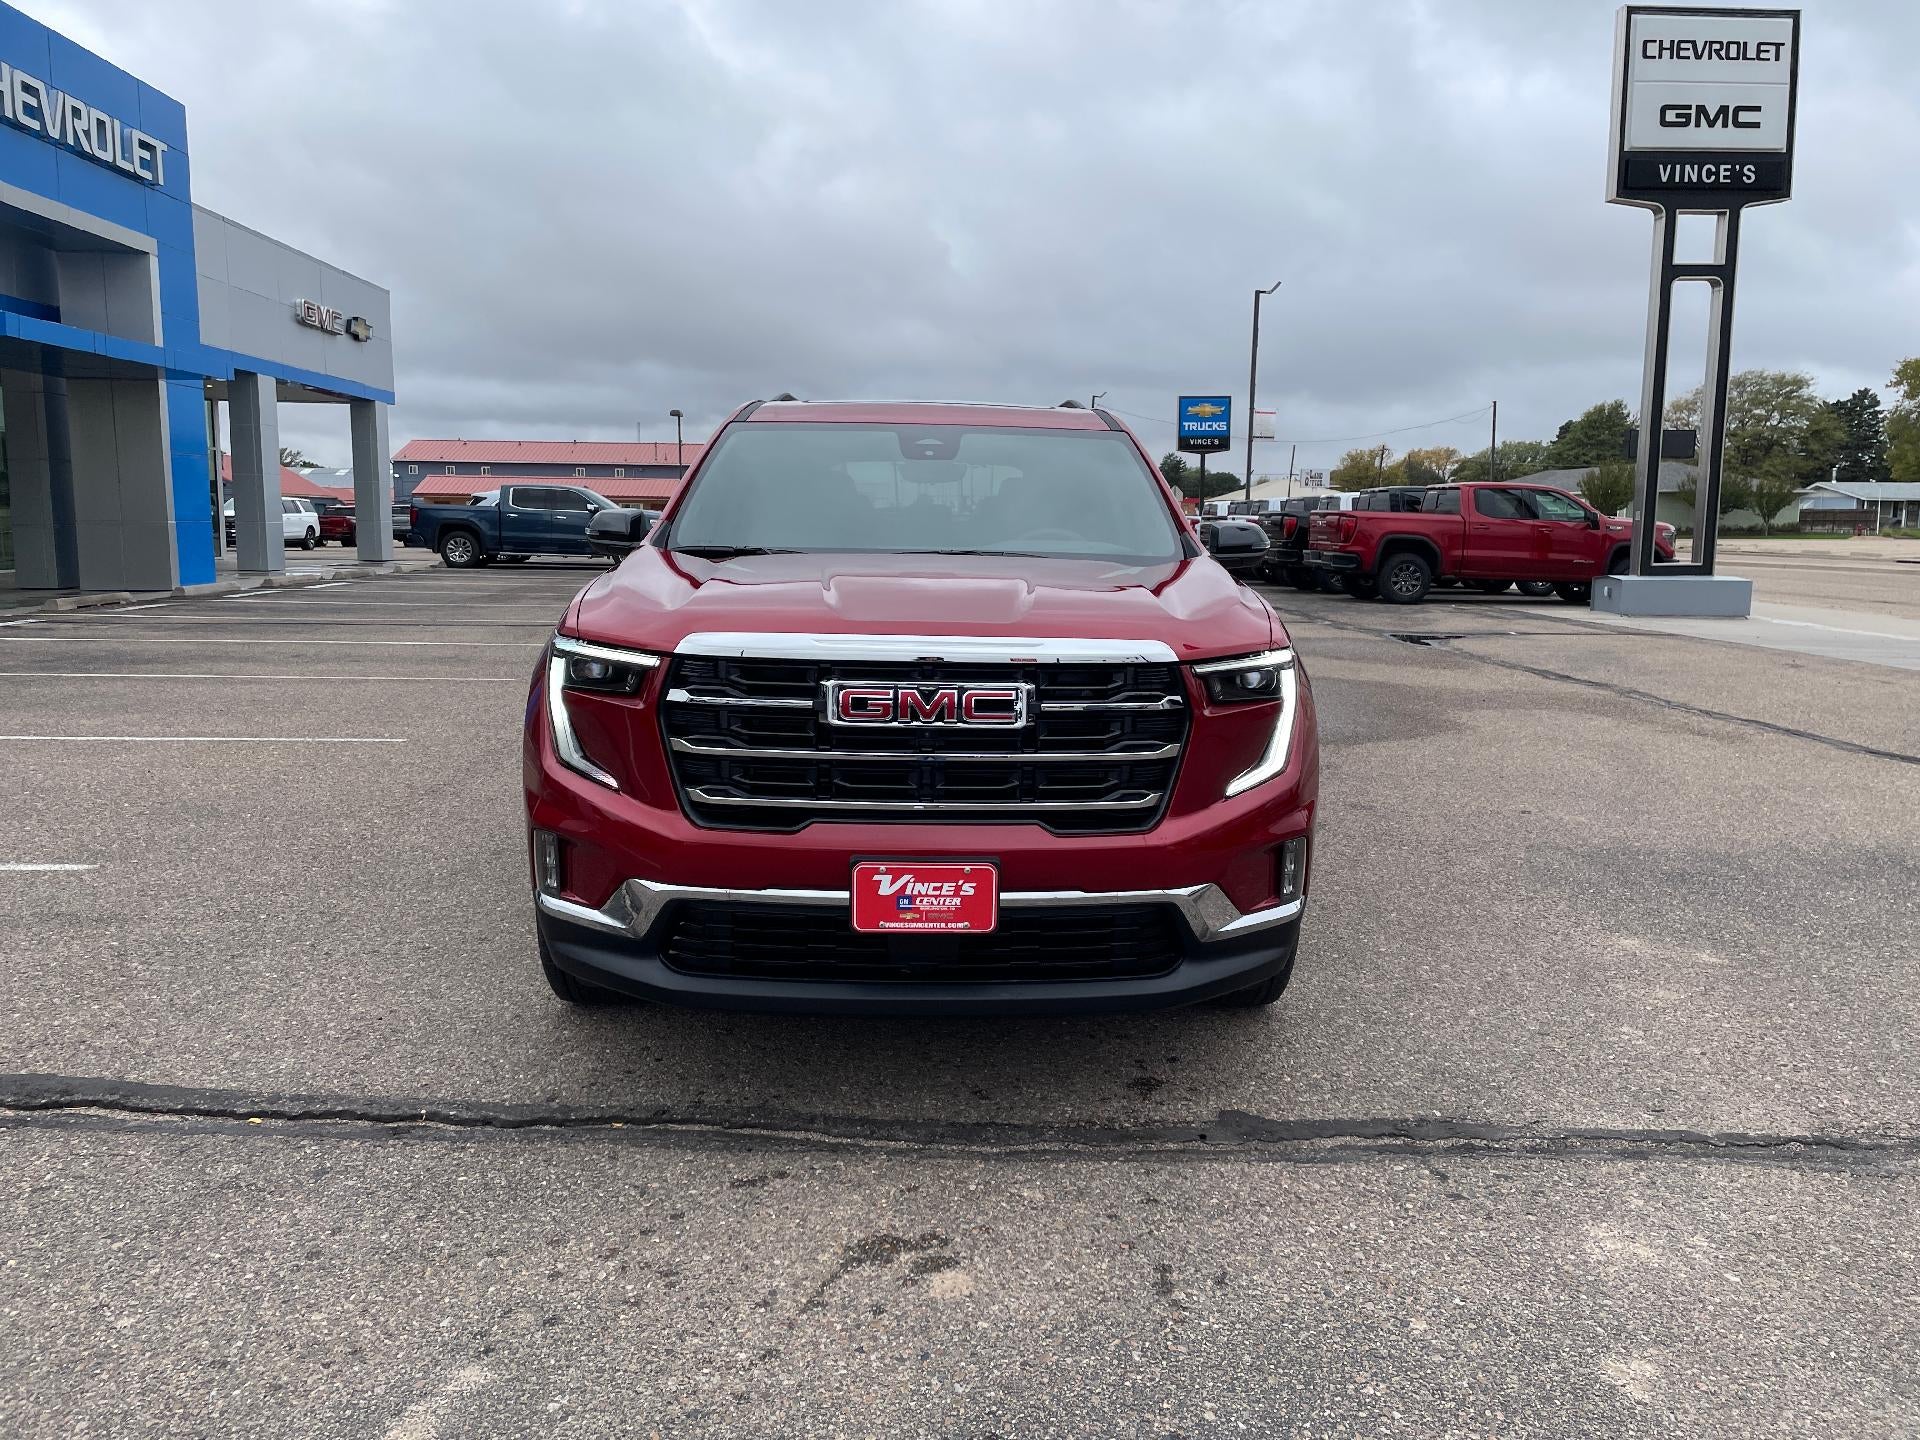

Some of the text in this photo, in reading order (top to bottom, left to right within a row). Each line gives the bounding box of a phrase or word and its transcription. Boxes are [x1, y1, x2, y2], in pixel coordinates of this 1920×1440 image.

[1642, 39, 1786, 62] CHEVROLET
[1659, 104, 1762, 129] GMC
[1659, 164, 1756, 184] VINCE'S
[304, 303, 344, 336] GMC
[1182, 421, 1227, 431] TRUCKS
[839, 688, 1017, 723] GMC
[915, 897, 962, 906] CENTER
